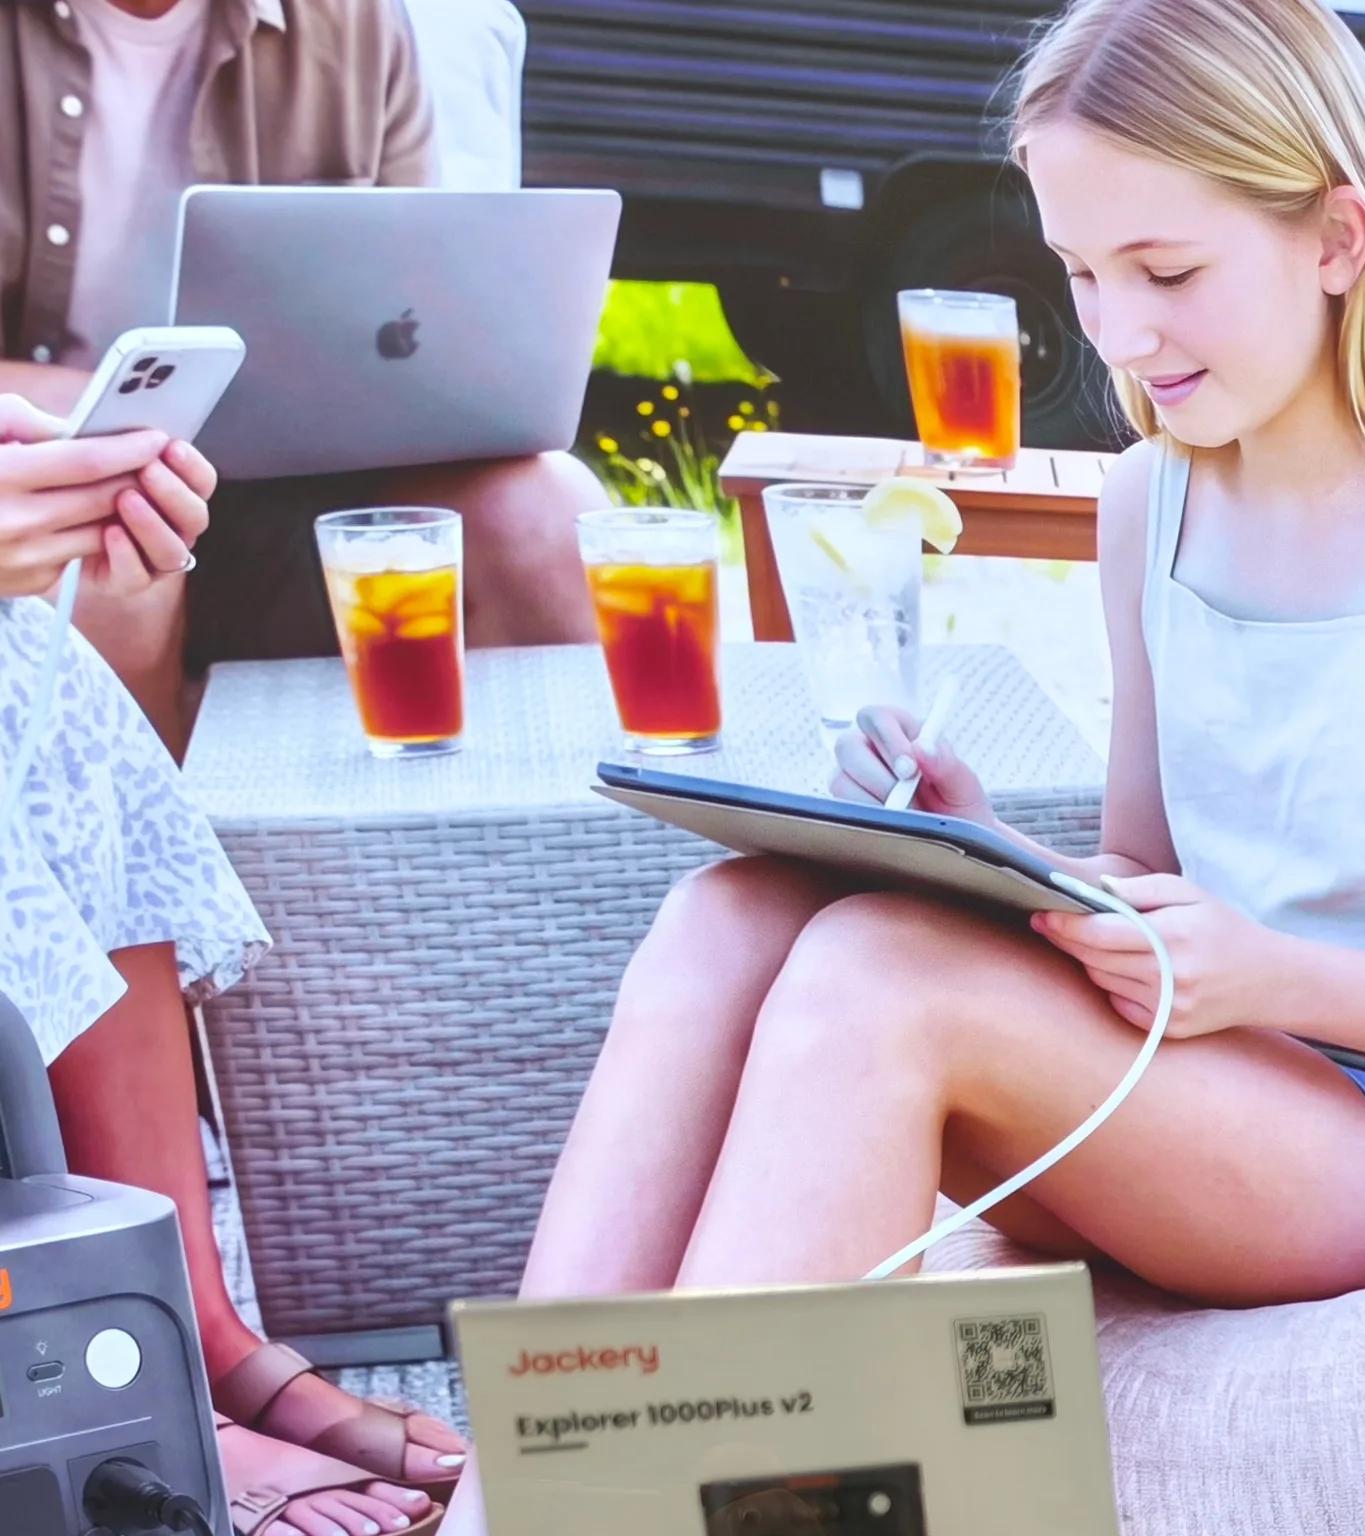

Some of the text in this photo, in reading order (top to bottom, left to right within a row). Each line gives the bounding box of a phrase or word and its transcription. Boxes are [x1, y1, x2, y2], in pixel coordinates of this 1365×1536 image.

[509, 1344, 658, 1376] Jackery
[38, 1385, 62, 1398] LIGHT
[515, 1390, 813, 1439] Explorer 1000Plus v2
